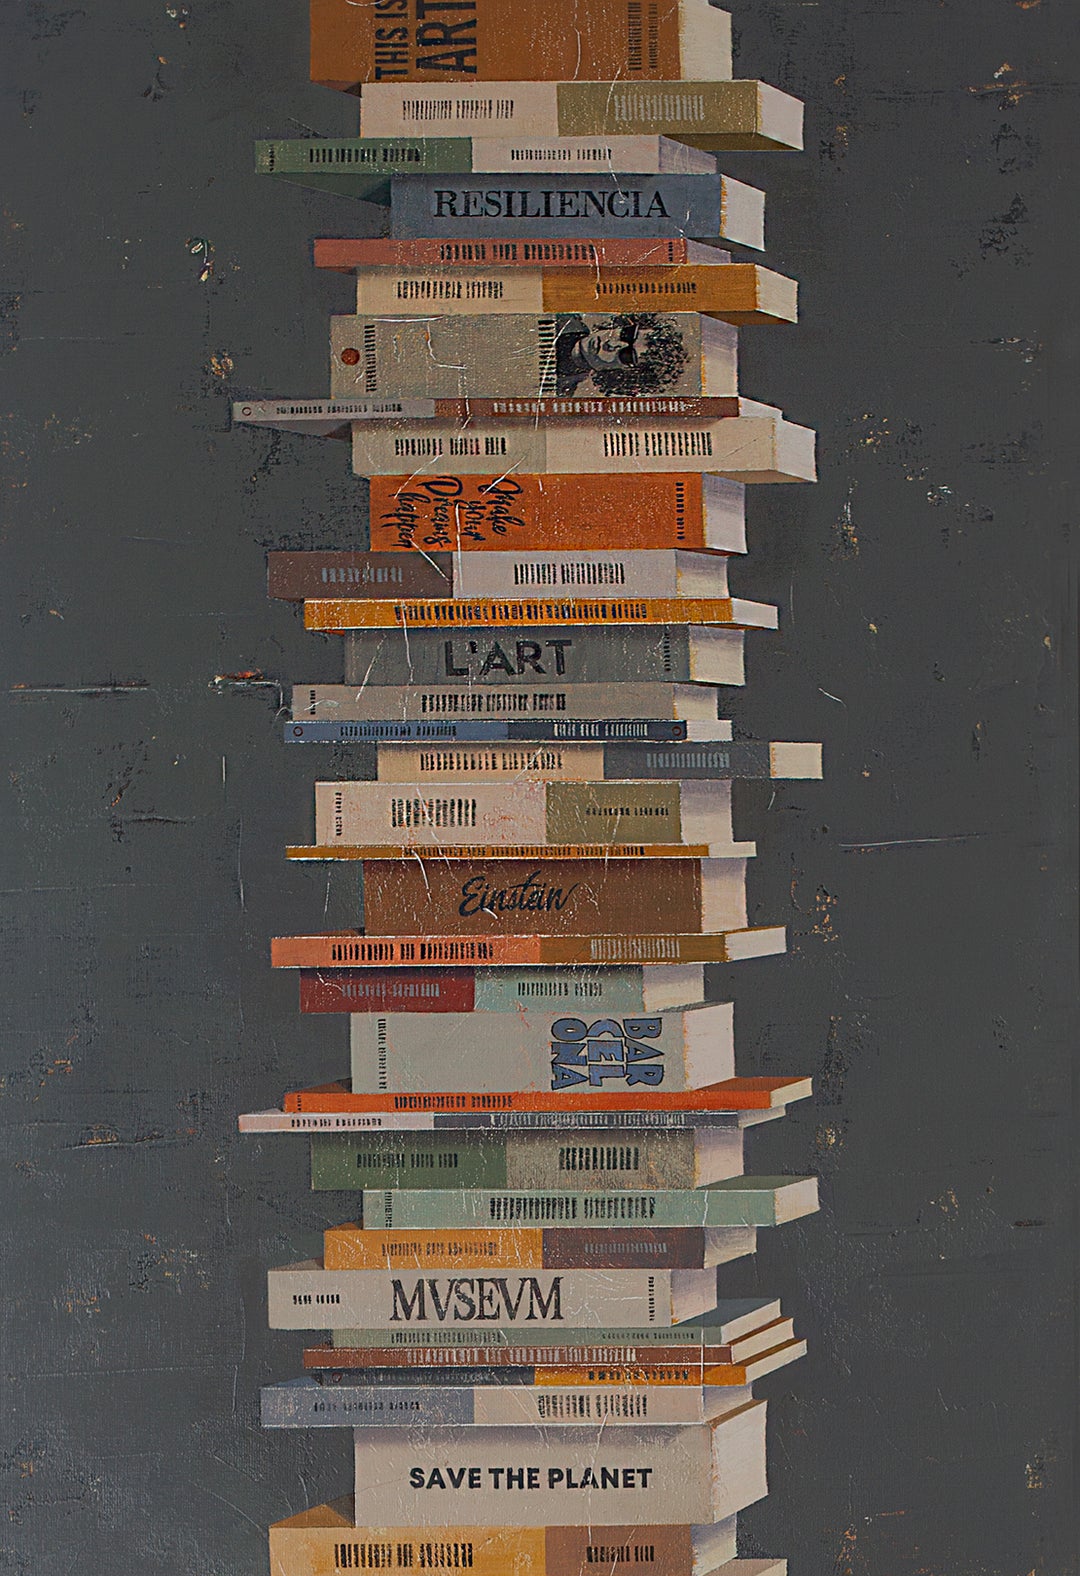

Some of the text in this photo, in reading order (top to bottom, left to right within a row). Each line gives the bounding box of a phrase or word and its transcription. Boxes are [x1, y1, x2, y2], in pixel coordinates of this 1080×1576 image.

[375, 0, 409, 80] THIS IS
[416, 0, 478, 74] ART
[433, 190, 671, 218] RESILIENCIA
[444, 639, 572, 677] L'ART
[459, 870, 579, 917] Einstein
[409, 1467, 653, 1490] SAVE THE PLANET
